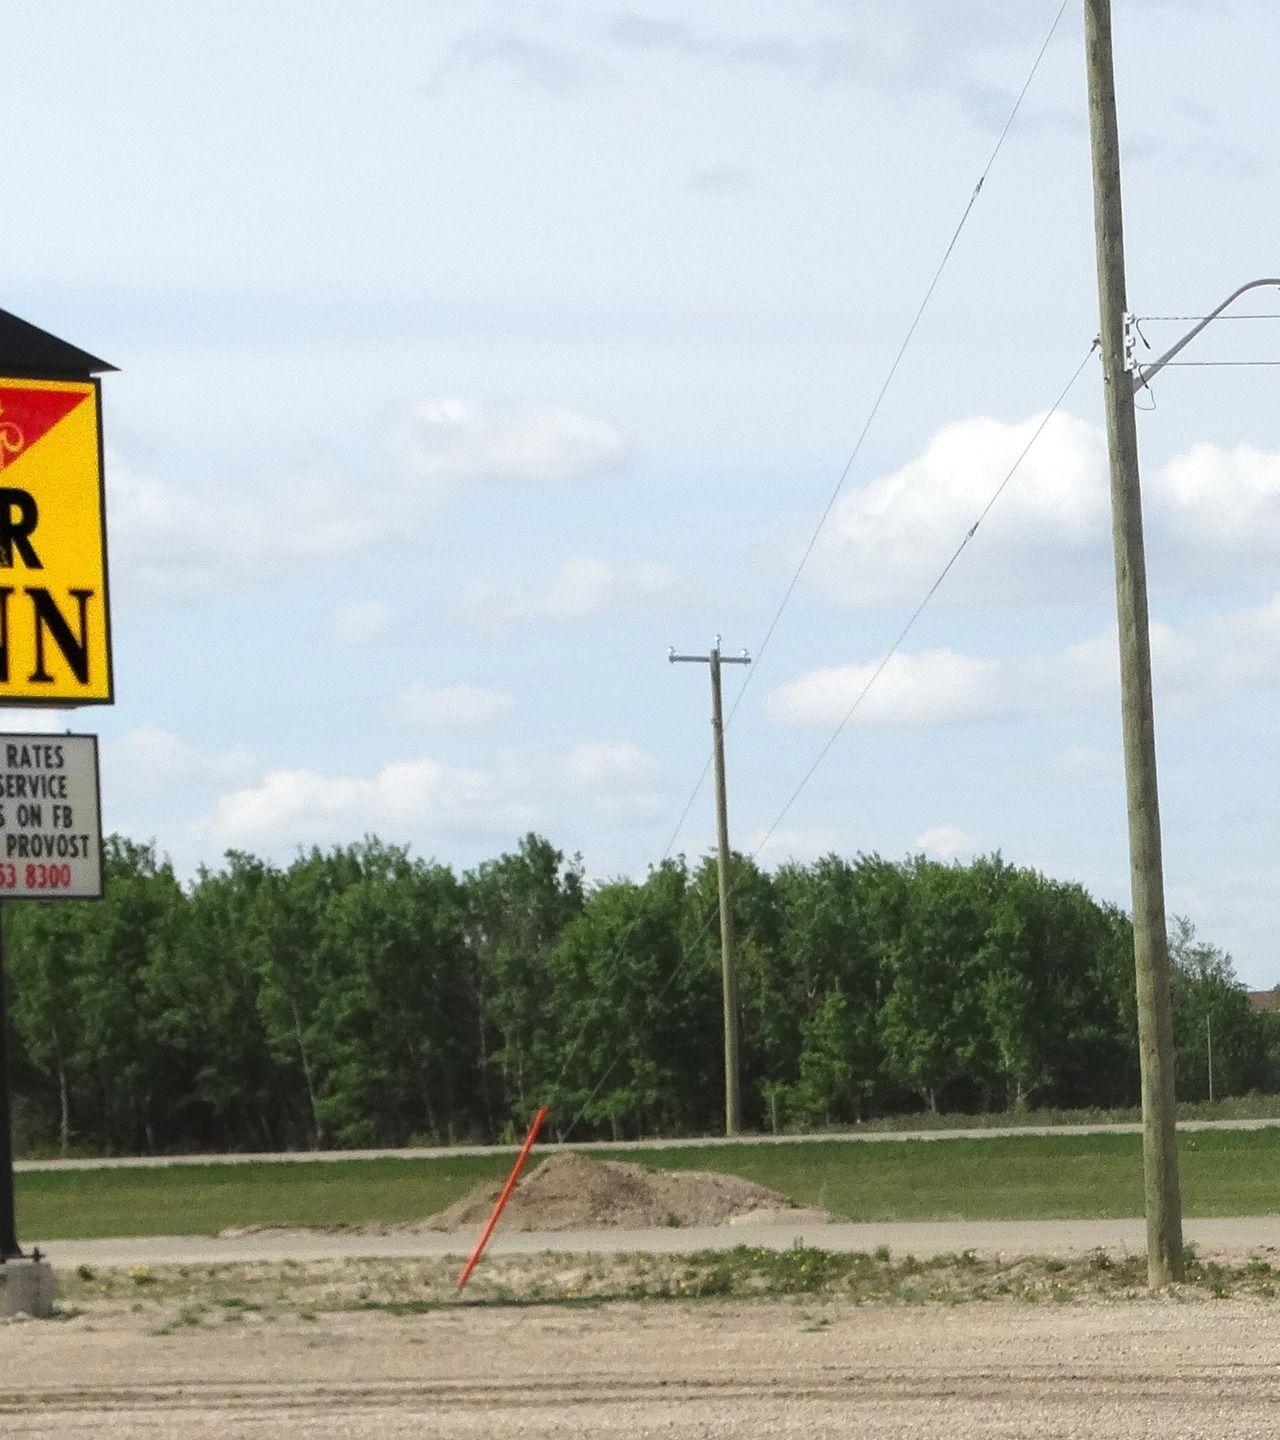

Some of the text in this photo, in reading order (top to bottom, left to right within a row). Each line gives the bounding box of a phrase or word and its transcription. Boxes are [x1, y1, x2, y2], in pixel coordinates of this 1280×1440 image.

[7, 746, 64, 769] RATES
[17, 804, 43, 828] ON
[53, 805, 73, 828] FB
[6, 835, 90, 858] PROVOST
[26, 863, 71, 889] 8300
